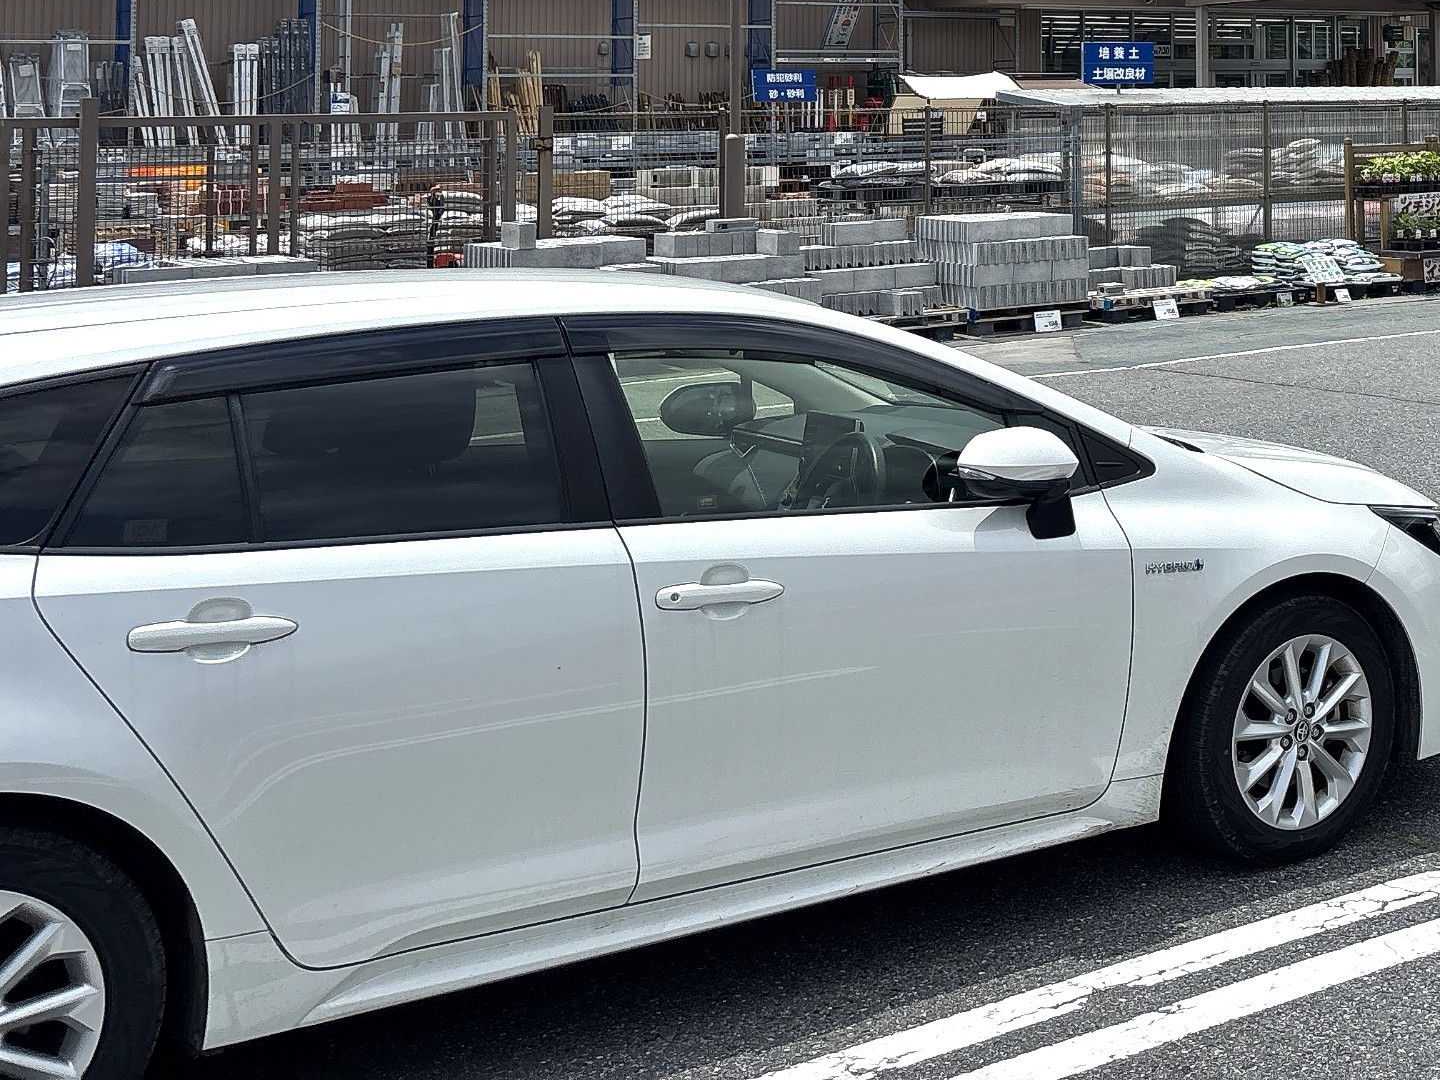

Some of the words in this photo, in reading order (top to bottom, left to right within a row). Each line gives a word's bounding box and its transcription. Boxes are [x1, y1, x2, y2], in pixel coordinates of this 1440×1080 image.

[1098, 46, 1140, 59] 培養土
[766, 72, 803, 83] 防犯砂利
[1092, 67, 1146, 80] 土壌改良材
